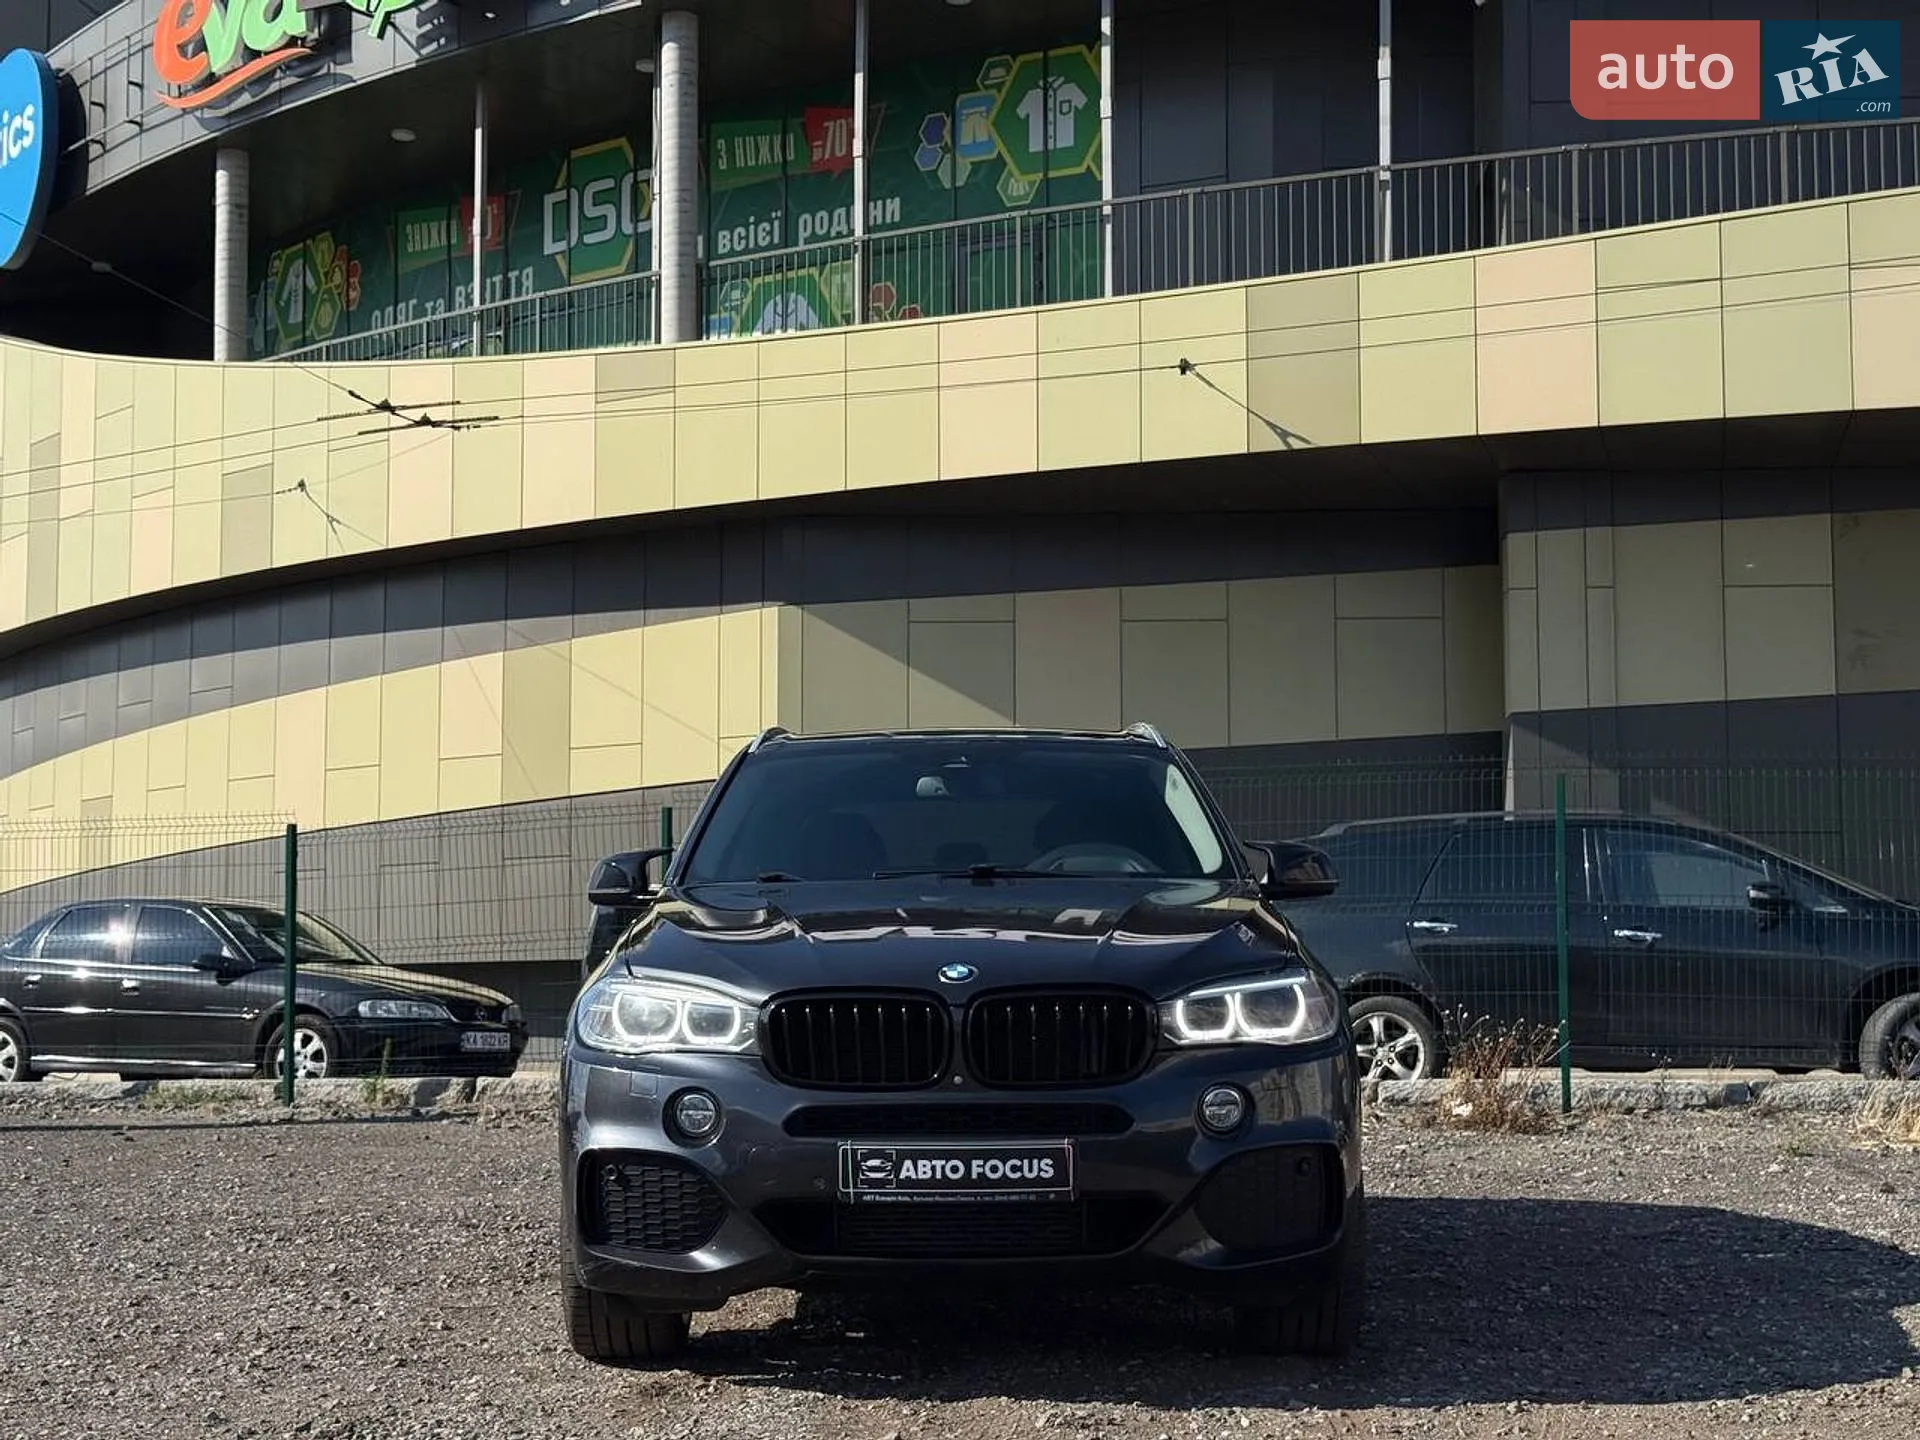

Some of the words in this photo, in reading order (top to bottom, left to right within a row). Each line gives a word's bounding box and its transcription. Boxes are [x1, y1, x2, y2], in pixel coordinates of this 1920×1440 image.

[0, 103, 35, 168] ics
[798, 196, 901, 247] родни
[899, 1158, 966, 1180] АВТО
[971, 1158, 1055, 1180] FOCUS
